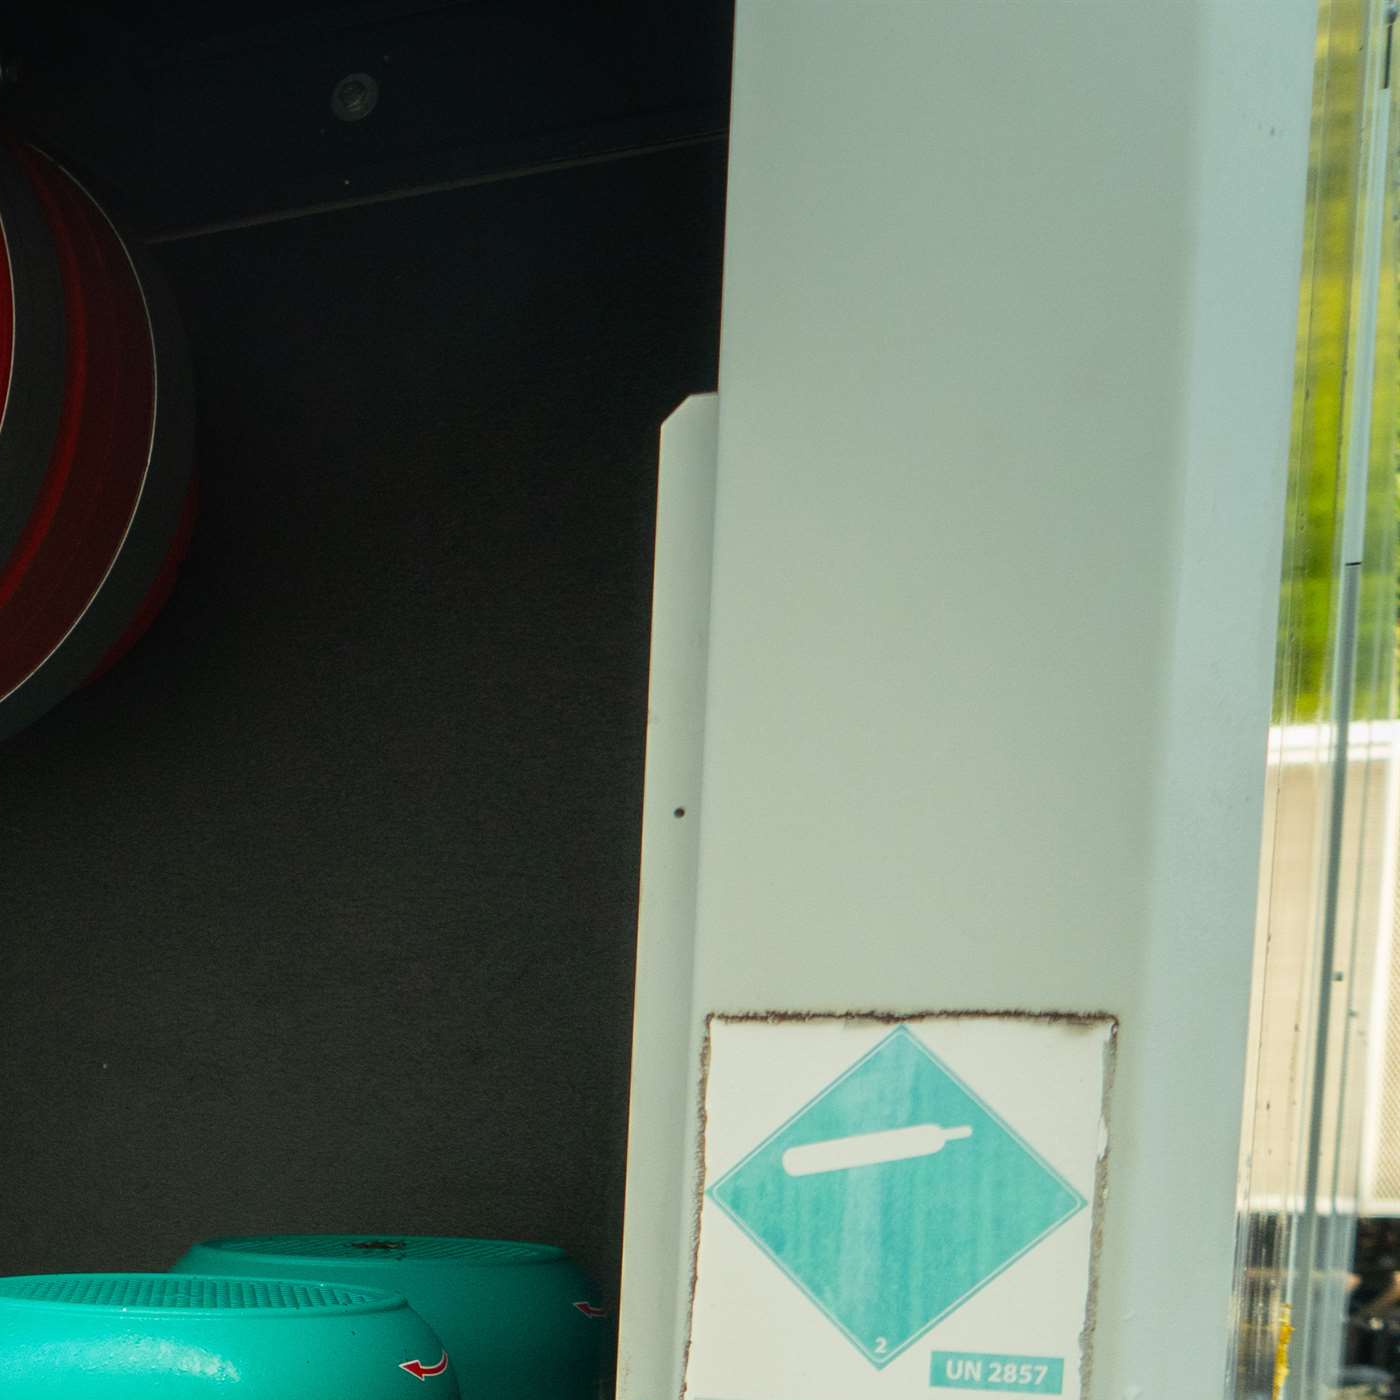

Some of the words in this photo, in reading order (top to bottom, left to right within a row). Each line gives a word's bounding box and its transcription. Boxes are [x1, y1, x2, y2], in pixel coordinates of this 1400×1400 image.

[874, 1337, 886, 1354] 2
[946, 1360, 981, 1382] UN
[988, 1363, 1048, 1385] 2857
